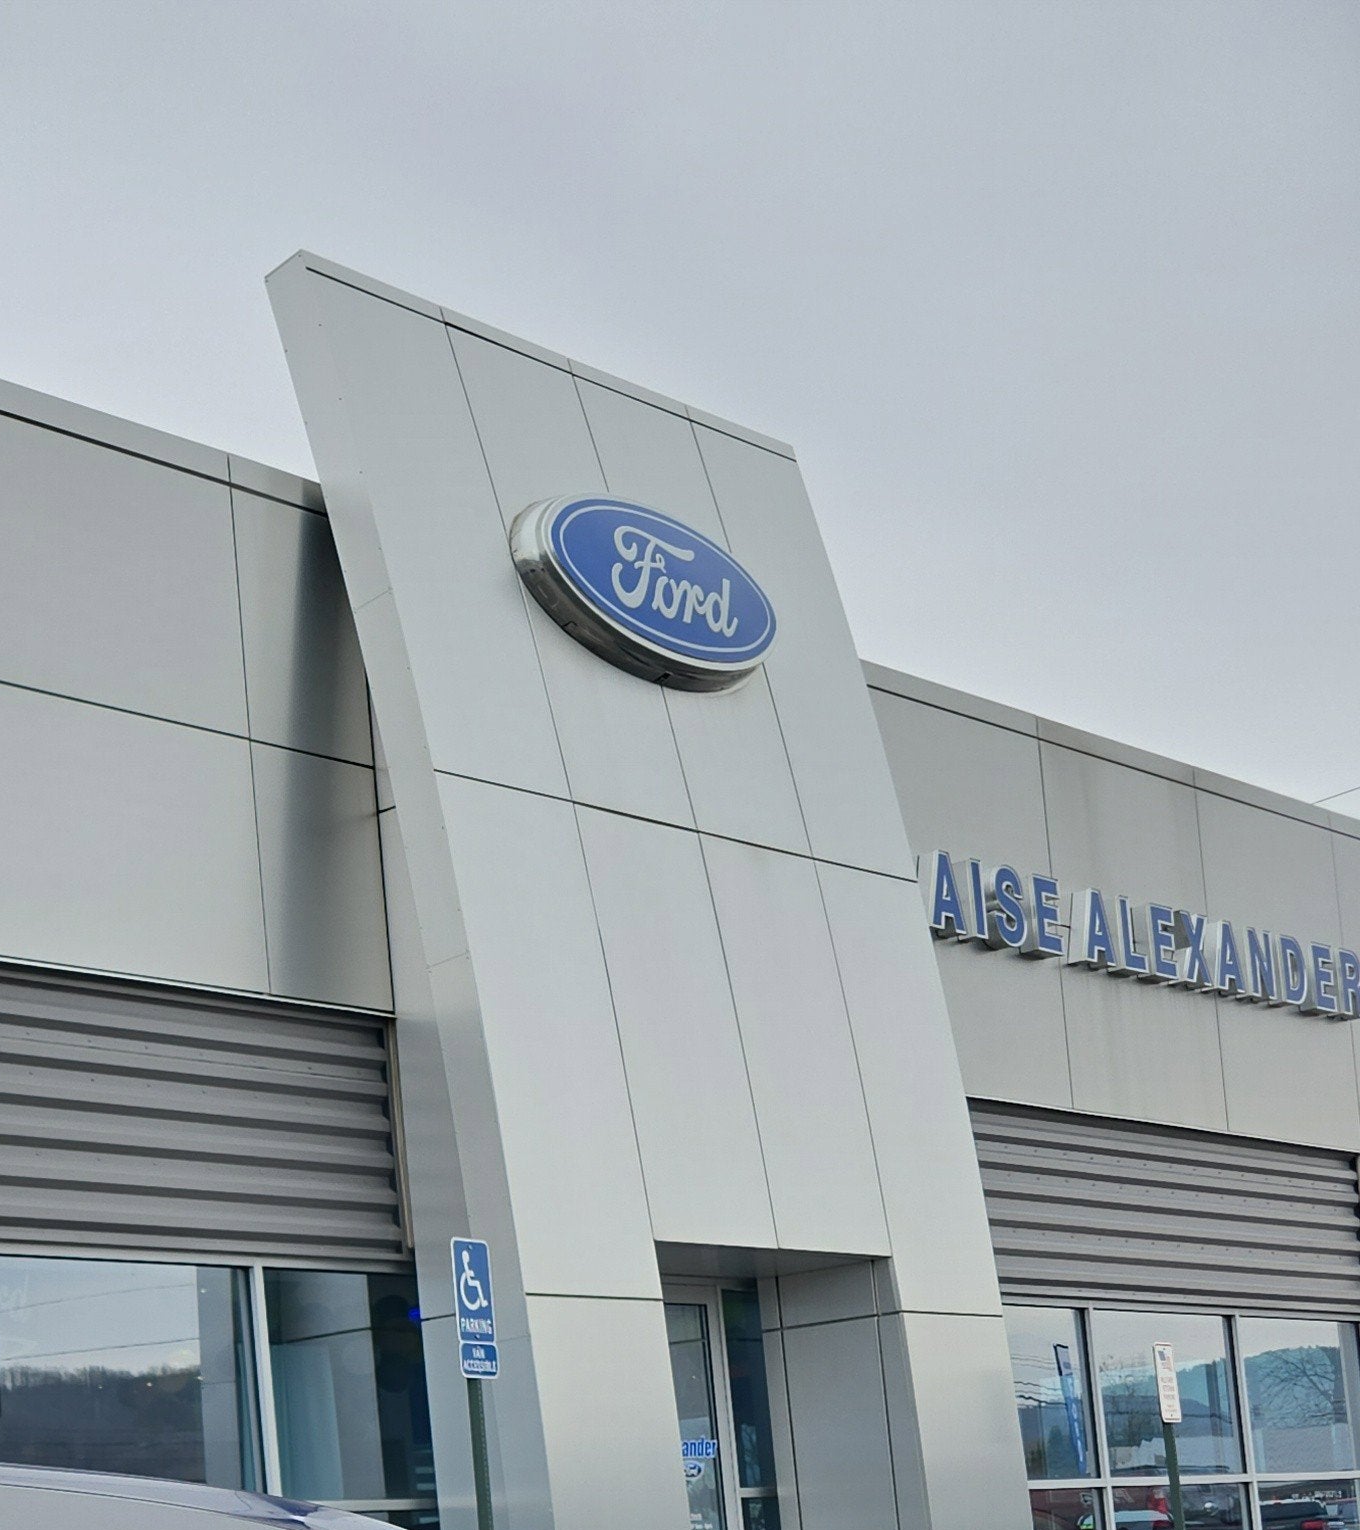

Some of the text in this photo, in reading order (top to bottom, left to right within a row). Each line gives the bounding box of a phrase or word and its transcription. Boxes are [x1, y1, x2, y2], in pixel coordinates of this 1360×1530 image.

[611, 525, 739, 637] Ford
[928, 849, 1360, 1018] AISE ALEXANDER
[460, 1317, 493, 1335] PARKING
